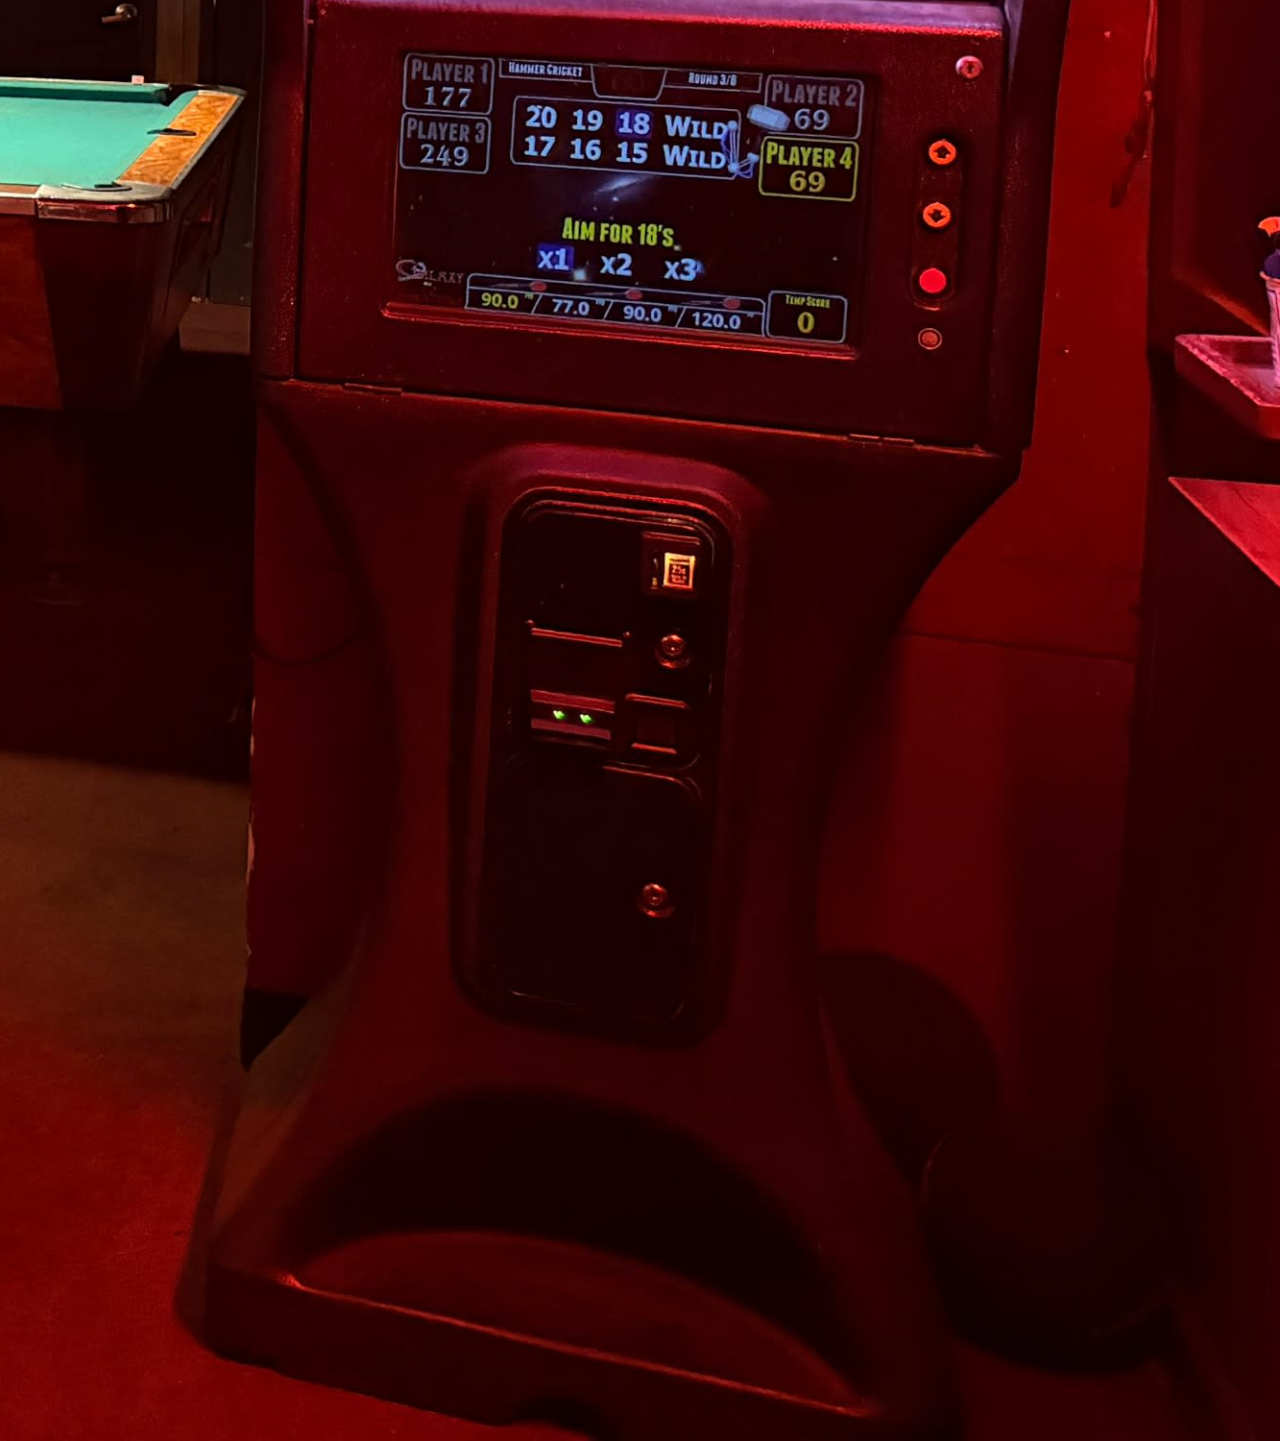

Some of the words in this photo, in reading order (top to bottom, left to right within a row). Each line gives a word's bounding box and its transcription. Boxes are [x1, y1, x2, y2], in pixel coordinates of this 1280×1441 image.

[411, 58, 475, 83] PLAYER
[480, 63, 489, 84] 1
[509, 61, 545, 76] HAMMER
[546, 64, 583, 77] CRICKET
[688, 72, 718, 85] ROUND
[424, 86, 472, 107] 177
[772, 79, 840, 106] PLAYER
[845, 85, 858, 107] 2
[406, 117, 471, 142] PLAYER
[475, 122, 486, 144] 3
[525, 104, 557, 128] 20
[572, 109, 604, 132] 19
[618, 113, 651, 135] 18
[794, 108, 830, 131] 69
[420, 144, 469, 167] 249
[523, 135, 556, 157] 17
[570, 138, 602, 161] 16
[616, 141, 648, 163] 15
[766, 142, 835, 168] PLAYER
[839, 147, 853, 169] 4
[790, 170, 826, 193] 69
[562, 217, 595, 242] AIM
[600, 223, 632, 244] FOR
[537, 248, 570, 271] x1
[600, 253, 632, 276] x2
[663, 258, 697, 281] x3
[481, 292, 519, 309] 90.0
[552, 299, 590, 315] 77.0
[623, 306, 662, 322] 90.0
[692, 312, 741, 329] 120.0
[797, 312, 815, 334] 0
